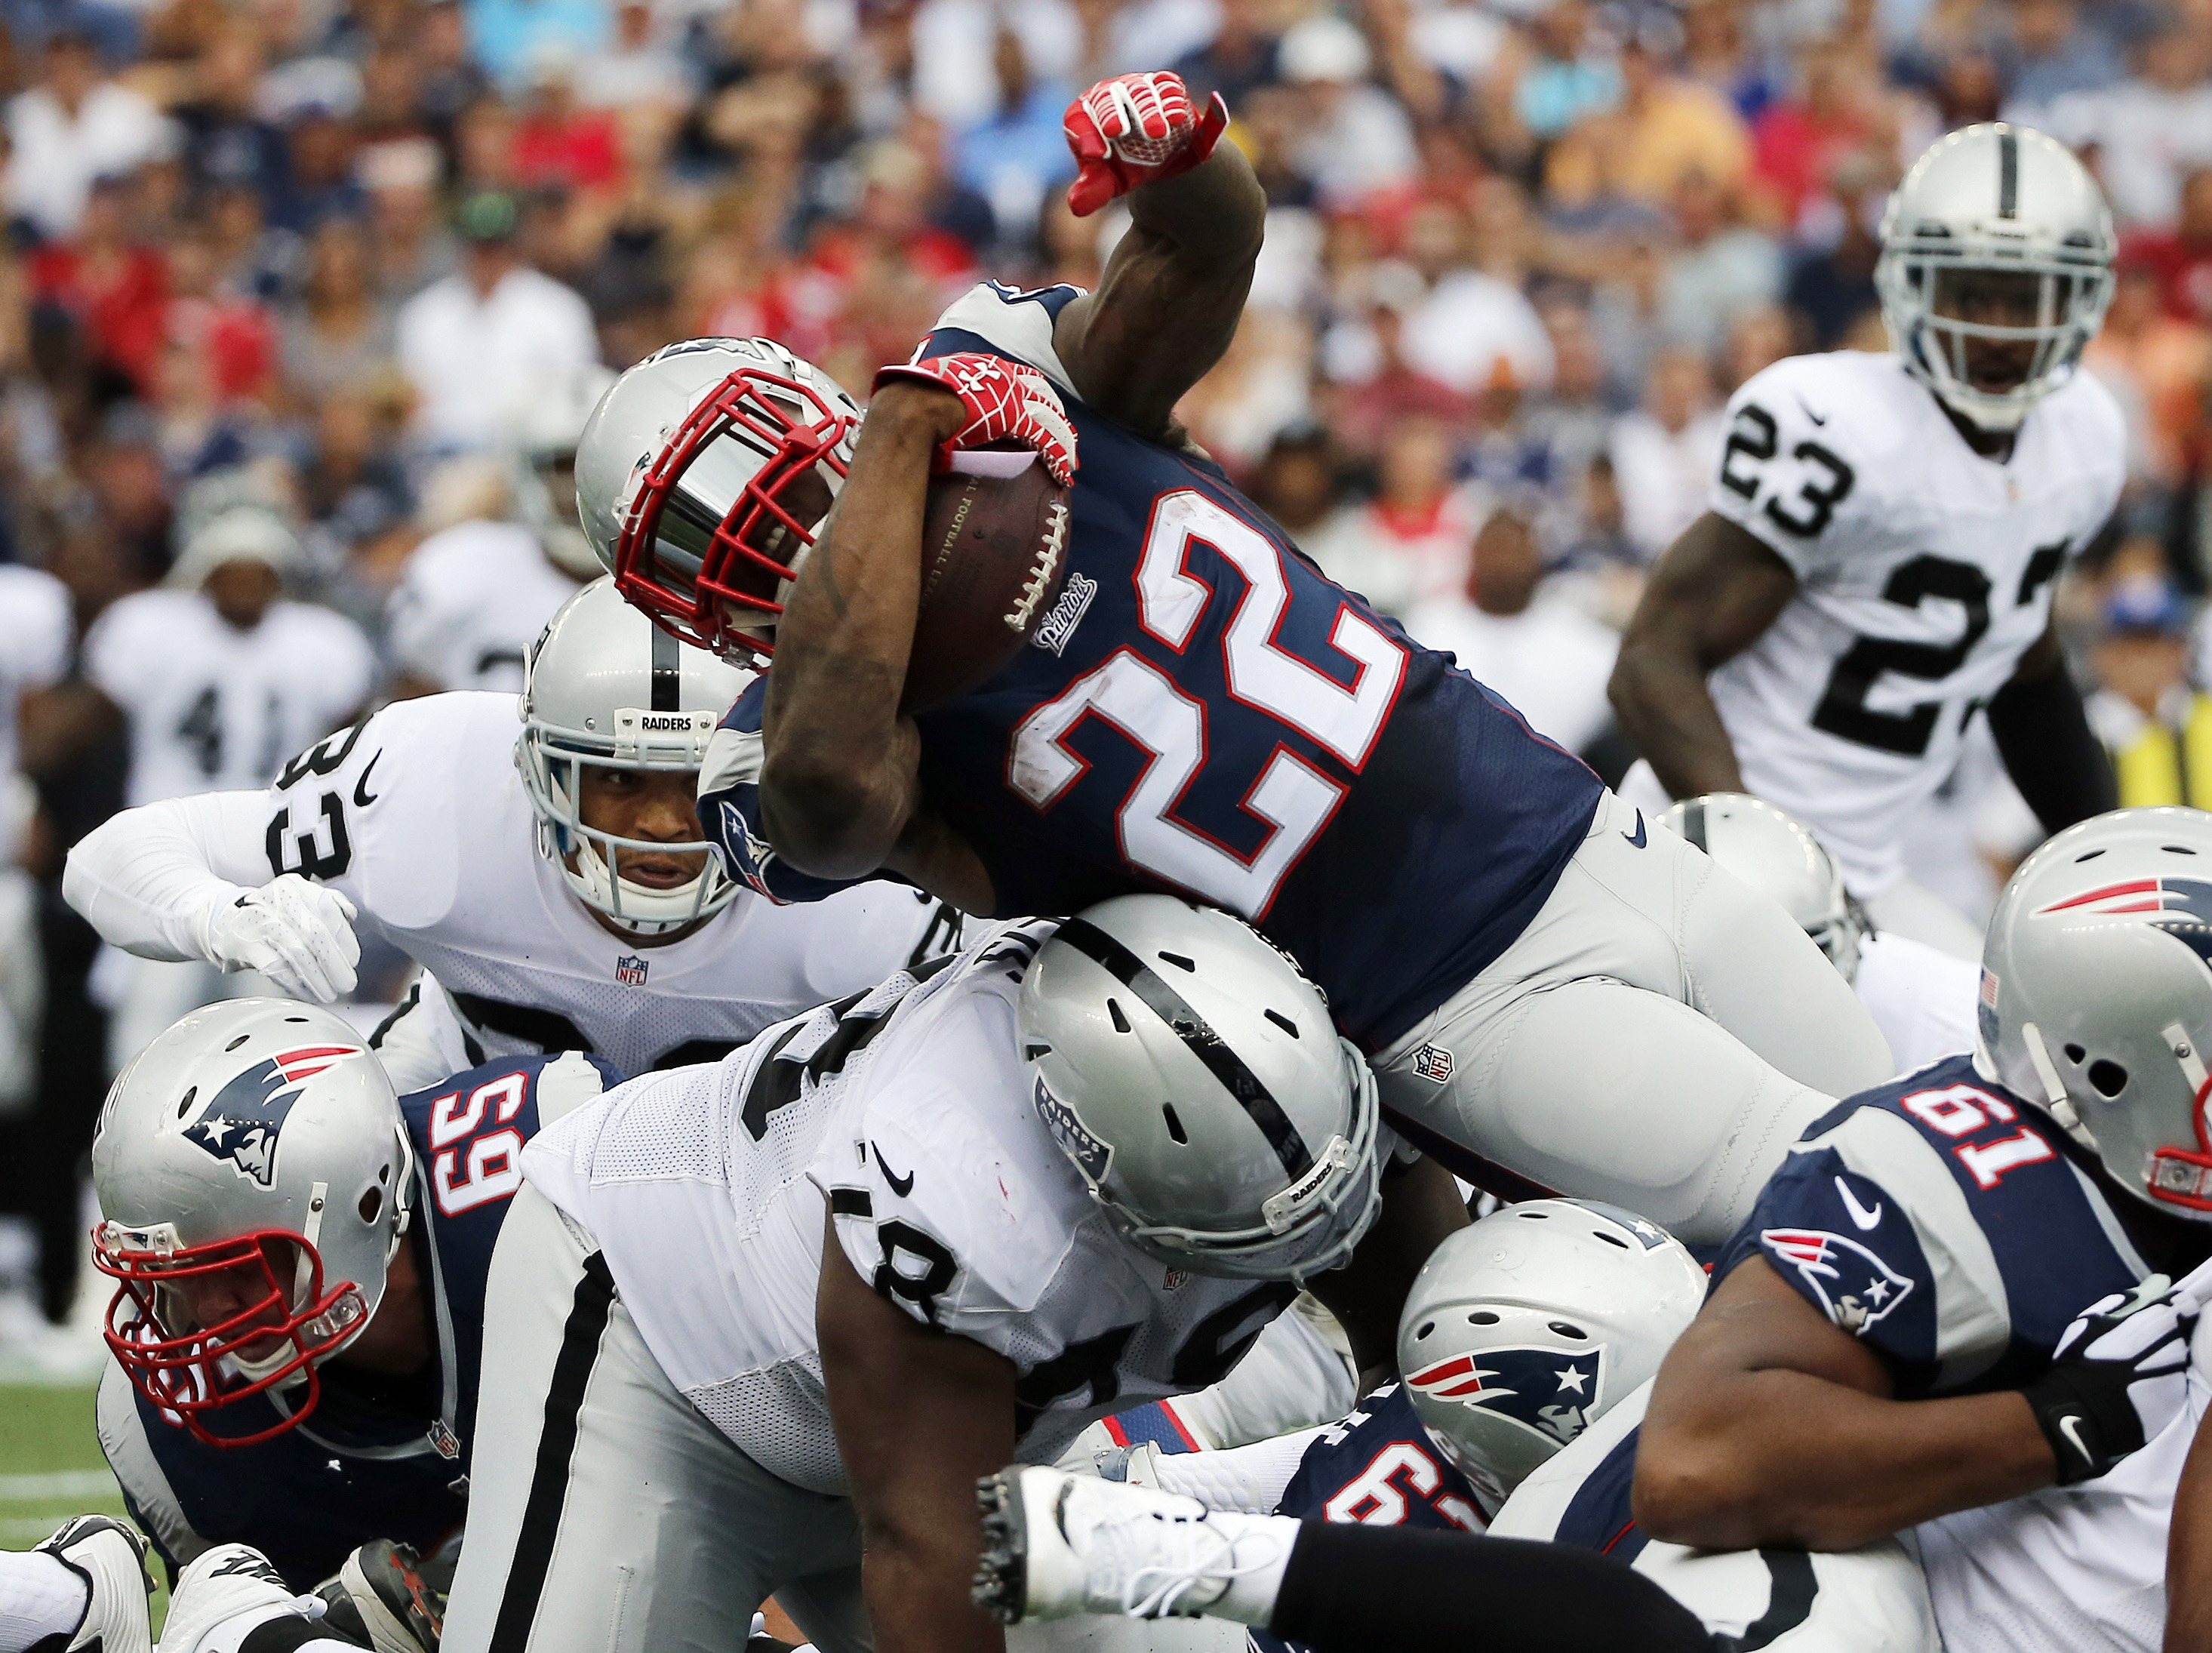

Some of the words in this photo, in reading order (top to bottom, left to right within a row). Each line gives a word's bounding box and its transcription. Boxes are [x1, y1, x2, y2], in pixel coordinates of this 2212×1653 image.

[1721, 402, 1854, 537] 23
[936, 497, 973, 563] FOOTBALL
[641, 716, 691, 731] RAIDERS
[1004, 487, 1410, 925] 22
[619, 968, 643, 983] NFL
[1429, 1054, 1450, 1079] NFL
[429, 1070, 529, 1217] 65
[1041, 1086, 1100, 1153] RAIDERS
[1900, 1082, 2057, 1192] 61
[1291, 1162, 1332, 1203] RAIDERS
[1164, 1270, 1188, 1288] NFL
[437, 1435, 456, 1454] NFL
